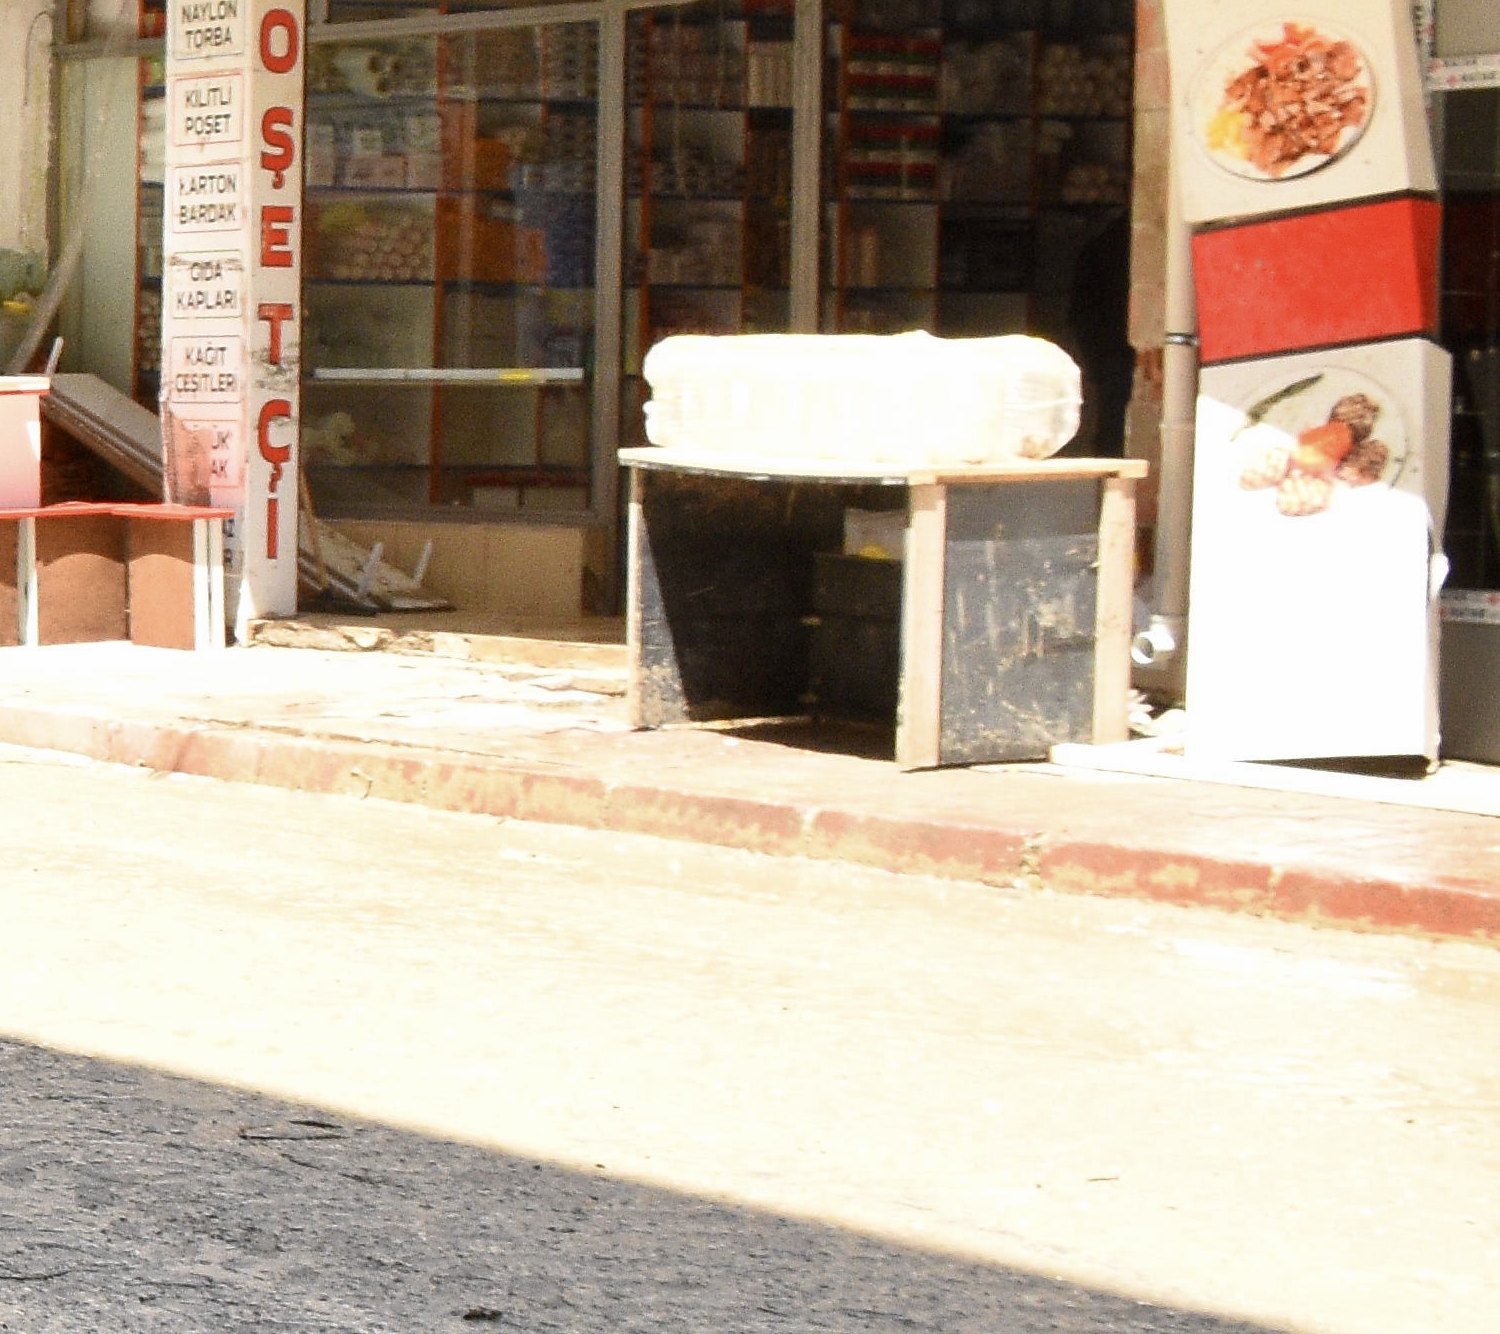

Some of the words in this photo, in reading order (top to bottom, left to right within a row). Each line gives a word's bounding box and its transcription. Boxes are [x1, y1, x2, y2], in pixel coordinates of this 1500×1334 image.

[185, 26, 233, 49] TORBA
[179, 173, 237, 197] KARTON
[180, 202, 237, 225] BARDAK
[177, 289, 237, 311] KAPLARI
